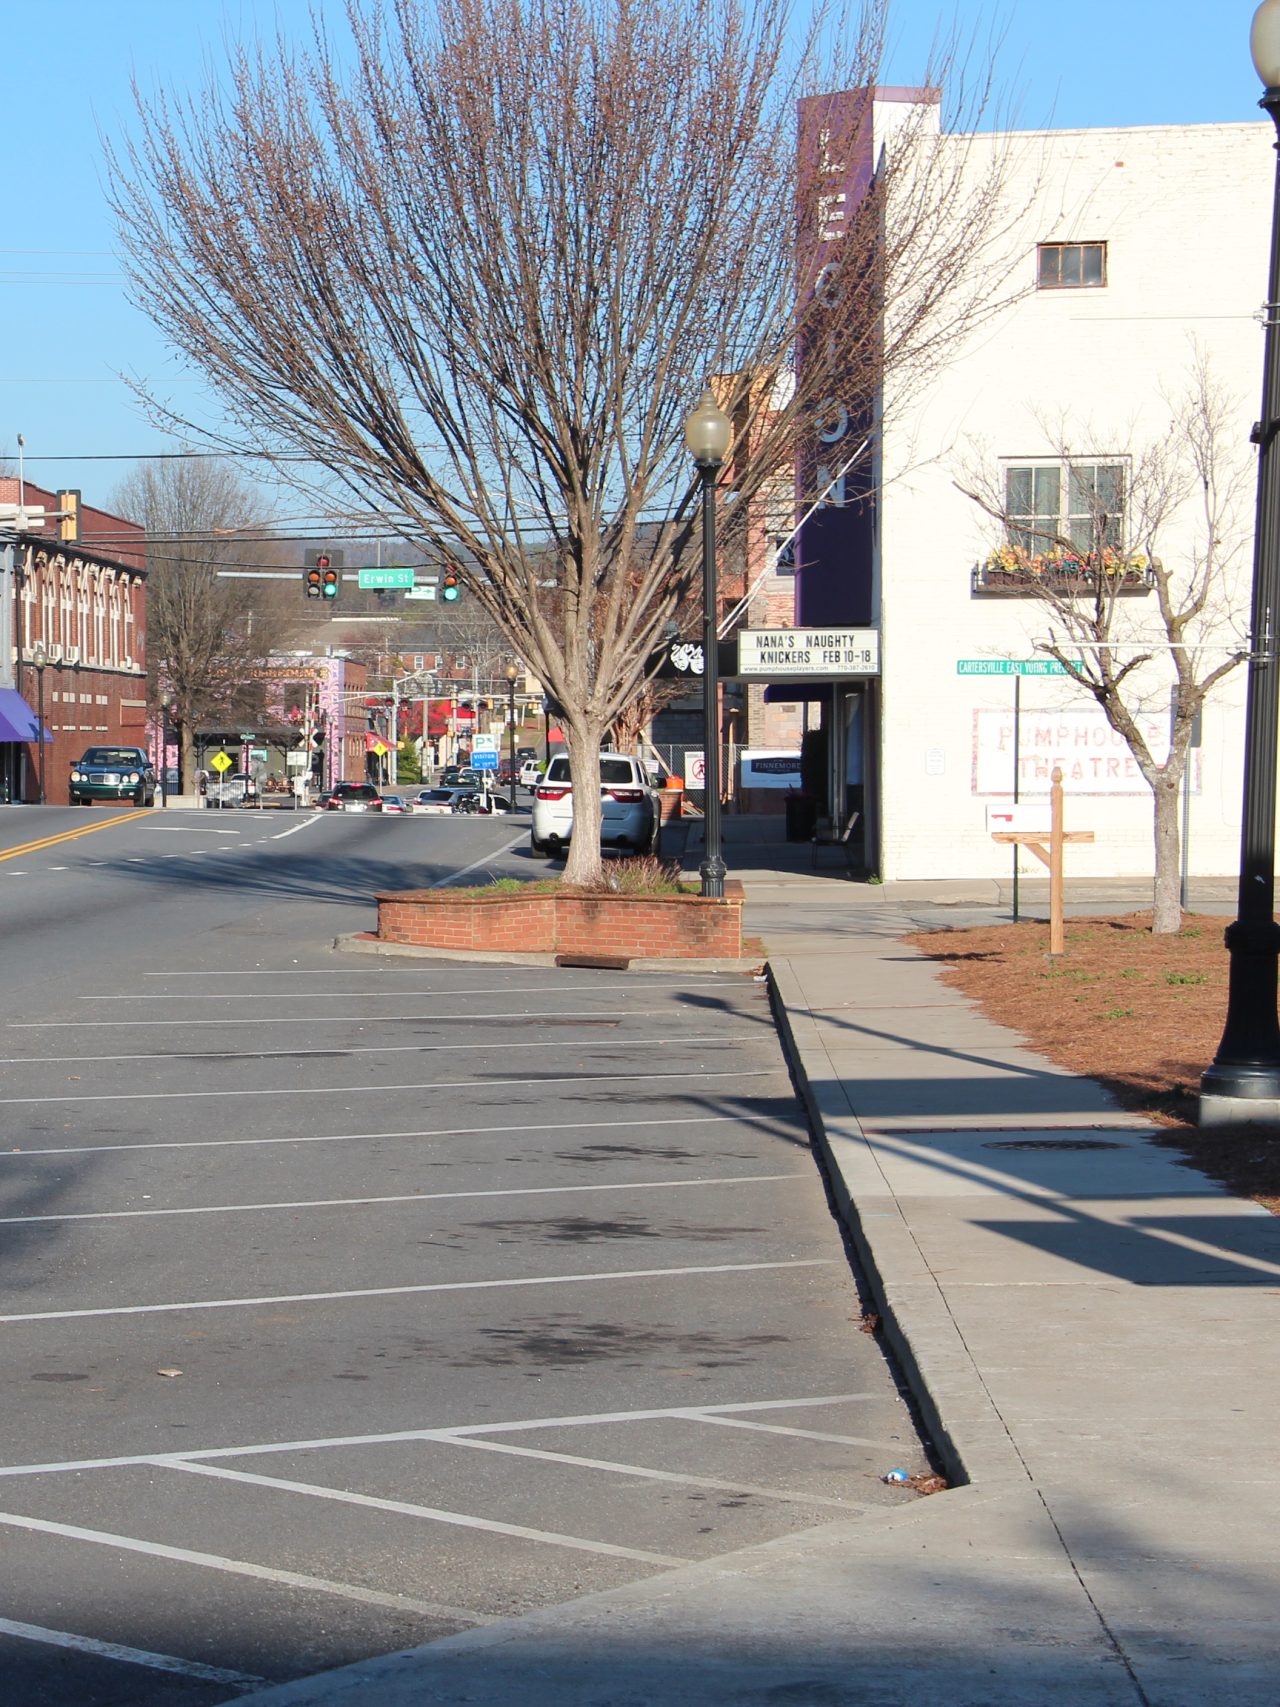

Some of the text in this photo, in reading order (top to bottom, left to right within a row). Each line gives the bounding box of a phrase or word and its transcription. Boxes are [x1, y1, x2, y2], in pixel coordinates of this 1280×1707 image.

[363, 574, 409, 584] Erwin St
[756, 635, 855, 648] NANA'S NAUGHTY
[760, 650, 871, 663] KNICKERS FEB 10-18
[744, 665, 829, 673] www.pumphouseplayers.com
[959, 661, 1004, 673] CARTERSVILLE
[1006, 661, 1022, 673] EAST
